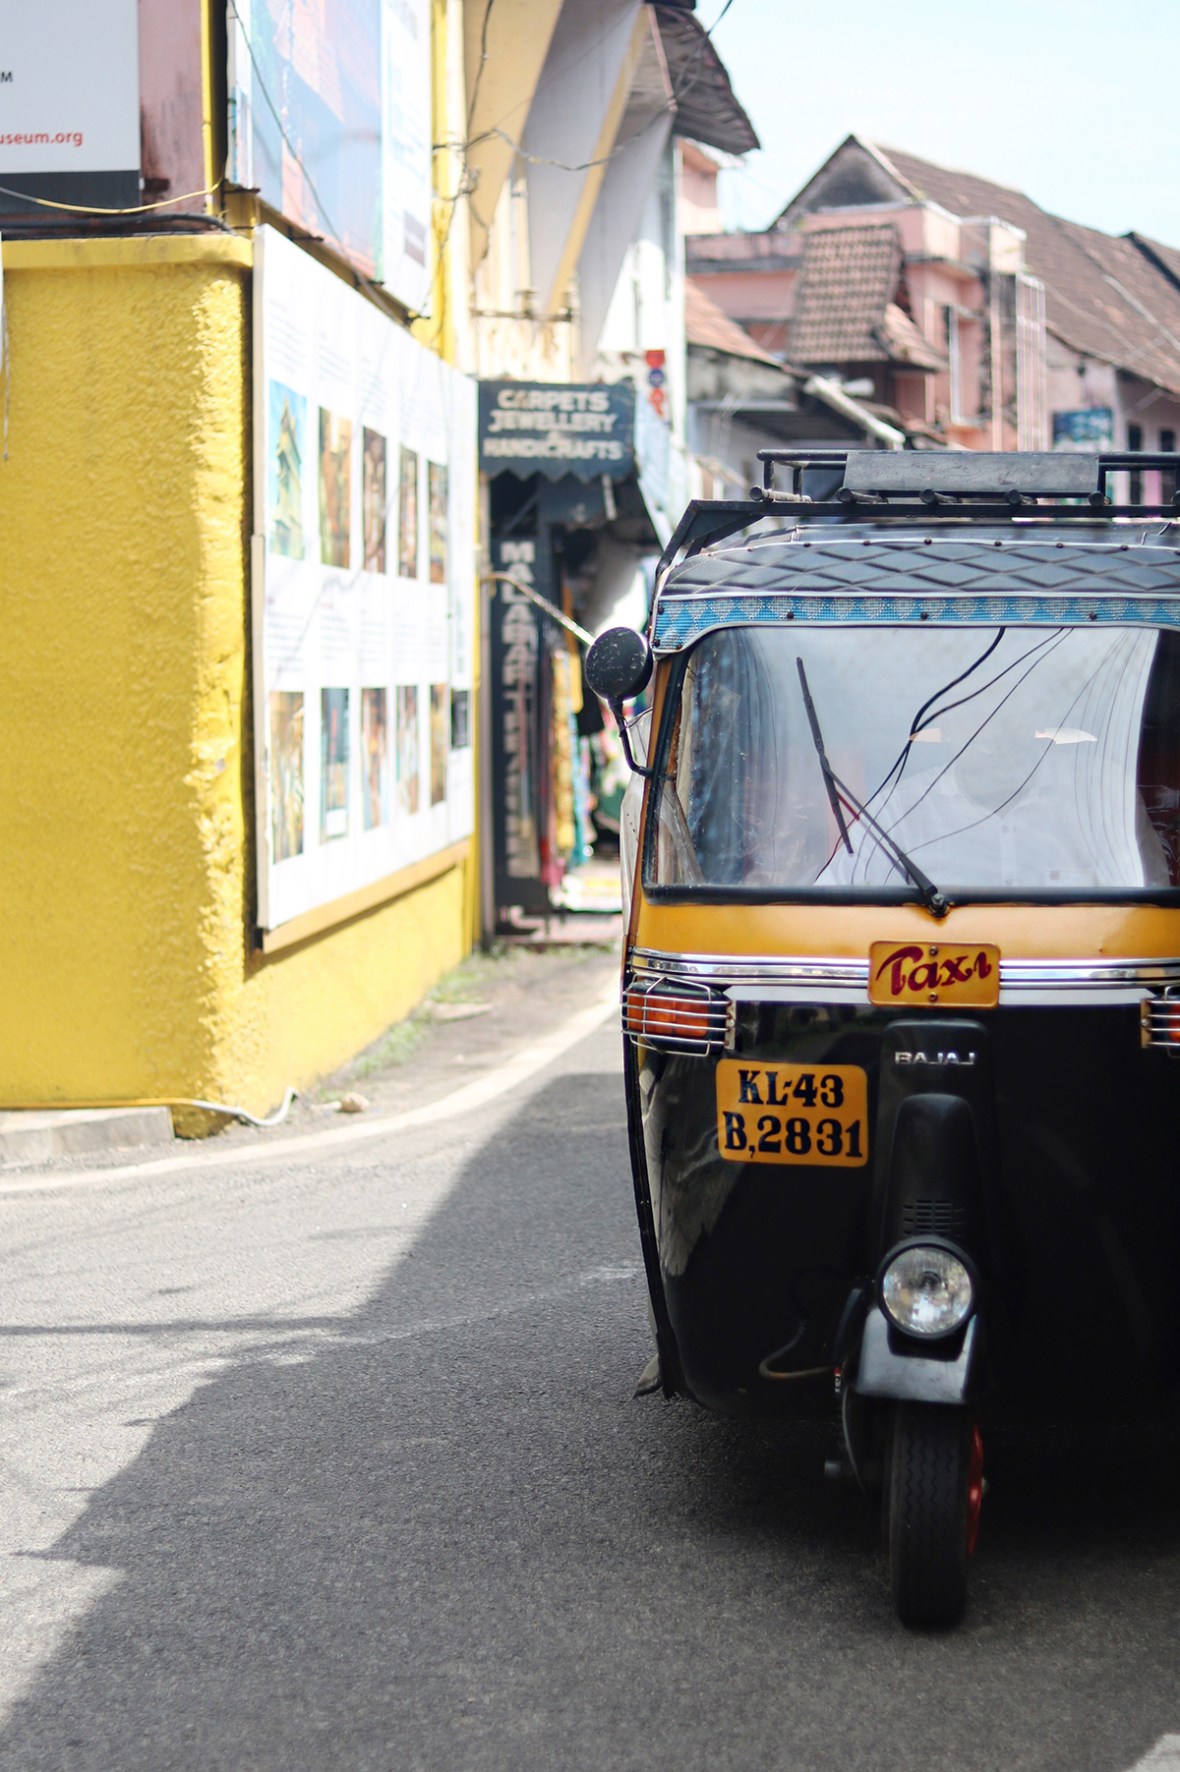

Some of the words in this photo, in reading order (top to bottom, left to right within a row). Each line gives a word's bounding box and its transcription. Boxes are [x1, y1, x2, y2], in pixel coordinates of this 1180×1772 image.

[497, 388, 610, 412] CARPETS
[487, 409, 618, 433] JEWELLERY
[482, 438, 623, 461] HANDICRAFTS
[875, 945, 992, 996] Taxi
[894, 1051, 976, 1066] BAJAJ
[737, 1068, 845, 1109] KL-43
